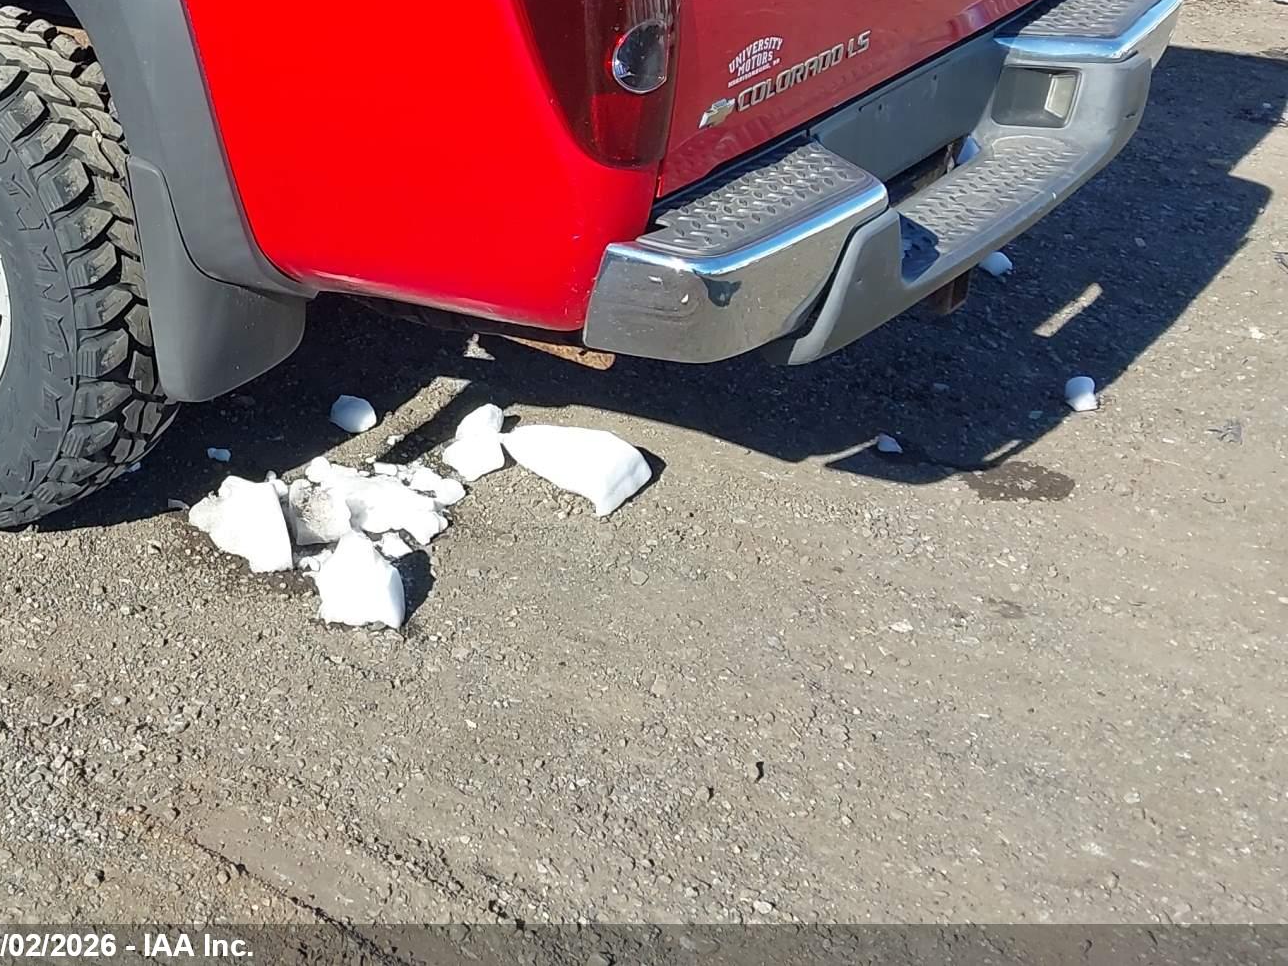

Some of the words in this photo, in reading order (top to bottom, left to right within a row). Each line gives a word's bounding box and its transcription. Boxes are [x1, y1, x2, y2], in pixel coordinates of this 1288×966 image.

[728, 36, 783, 74] UNIVERSITY
[737, 50, 774, 78] MOTORS
[737, 43, 844, 112] COLORADO
[847, 30, 871, 59] LS
